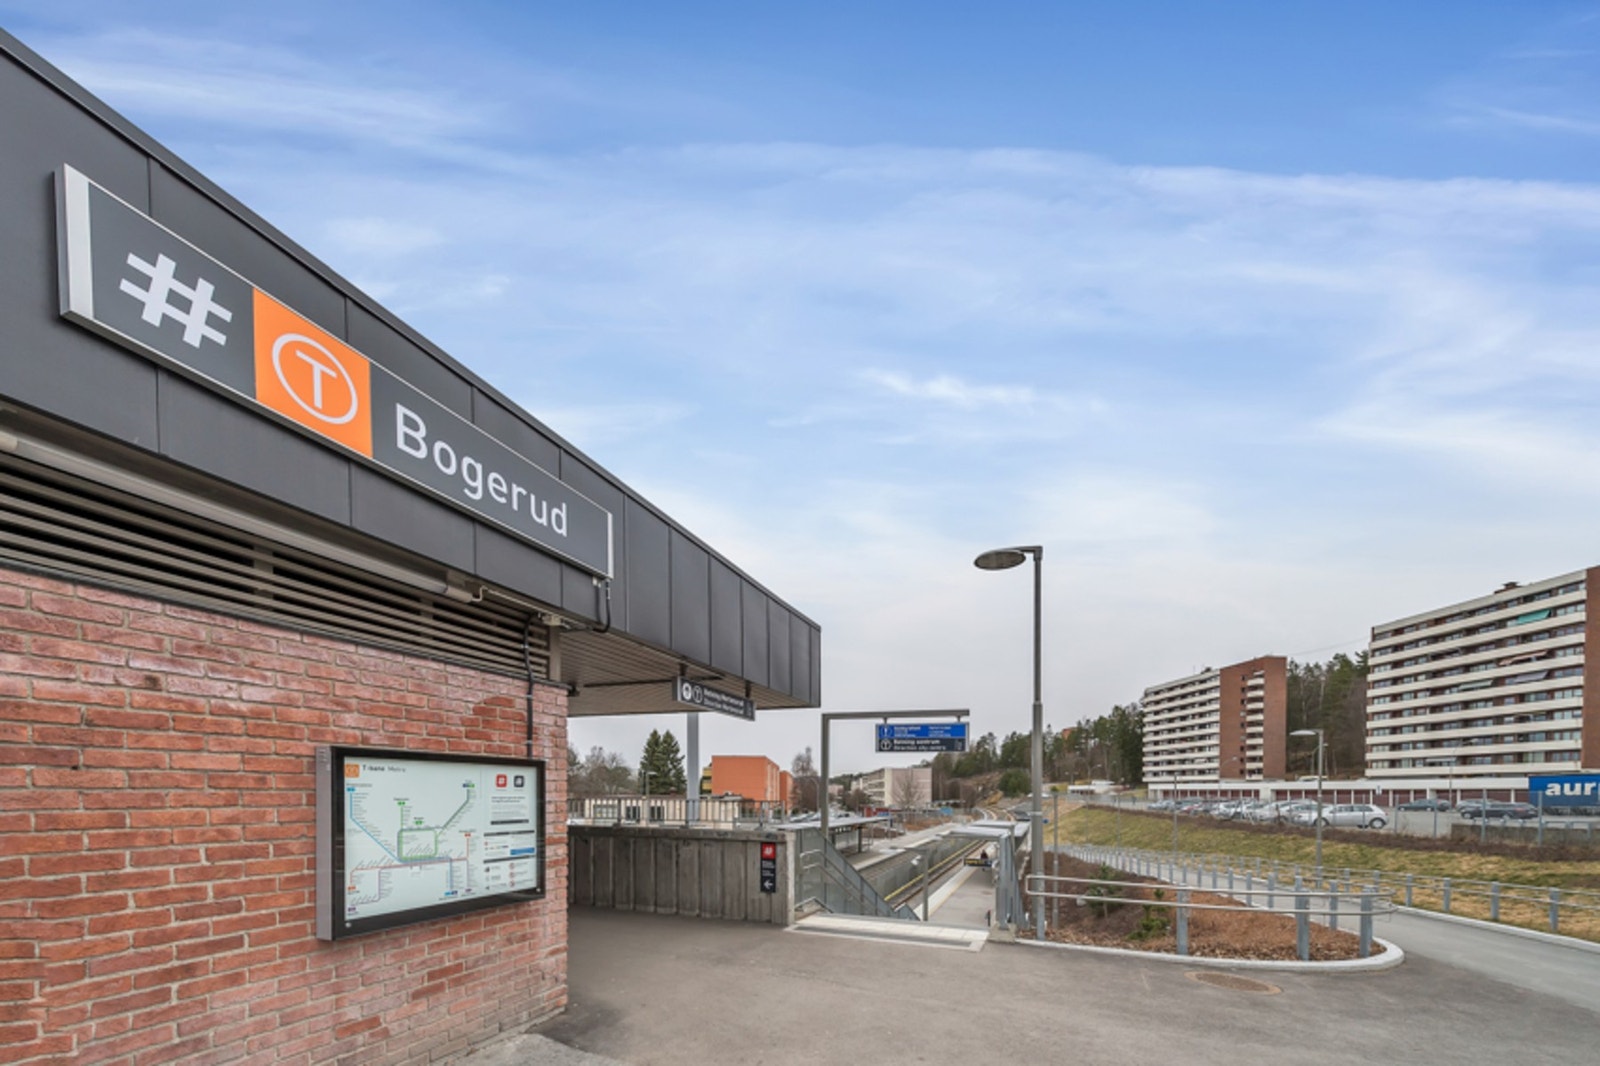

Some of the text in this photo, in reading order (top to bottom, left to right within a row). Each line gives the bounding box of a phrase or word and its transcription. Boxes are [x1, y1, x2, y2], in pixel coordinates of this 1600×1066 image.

[295, 349, 338, 409] T
[396, 402, 568, 538] Bogerud
[1545, 781, 1600, 801] aur
